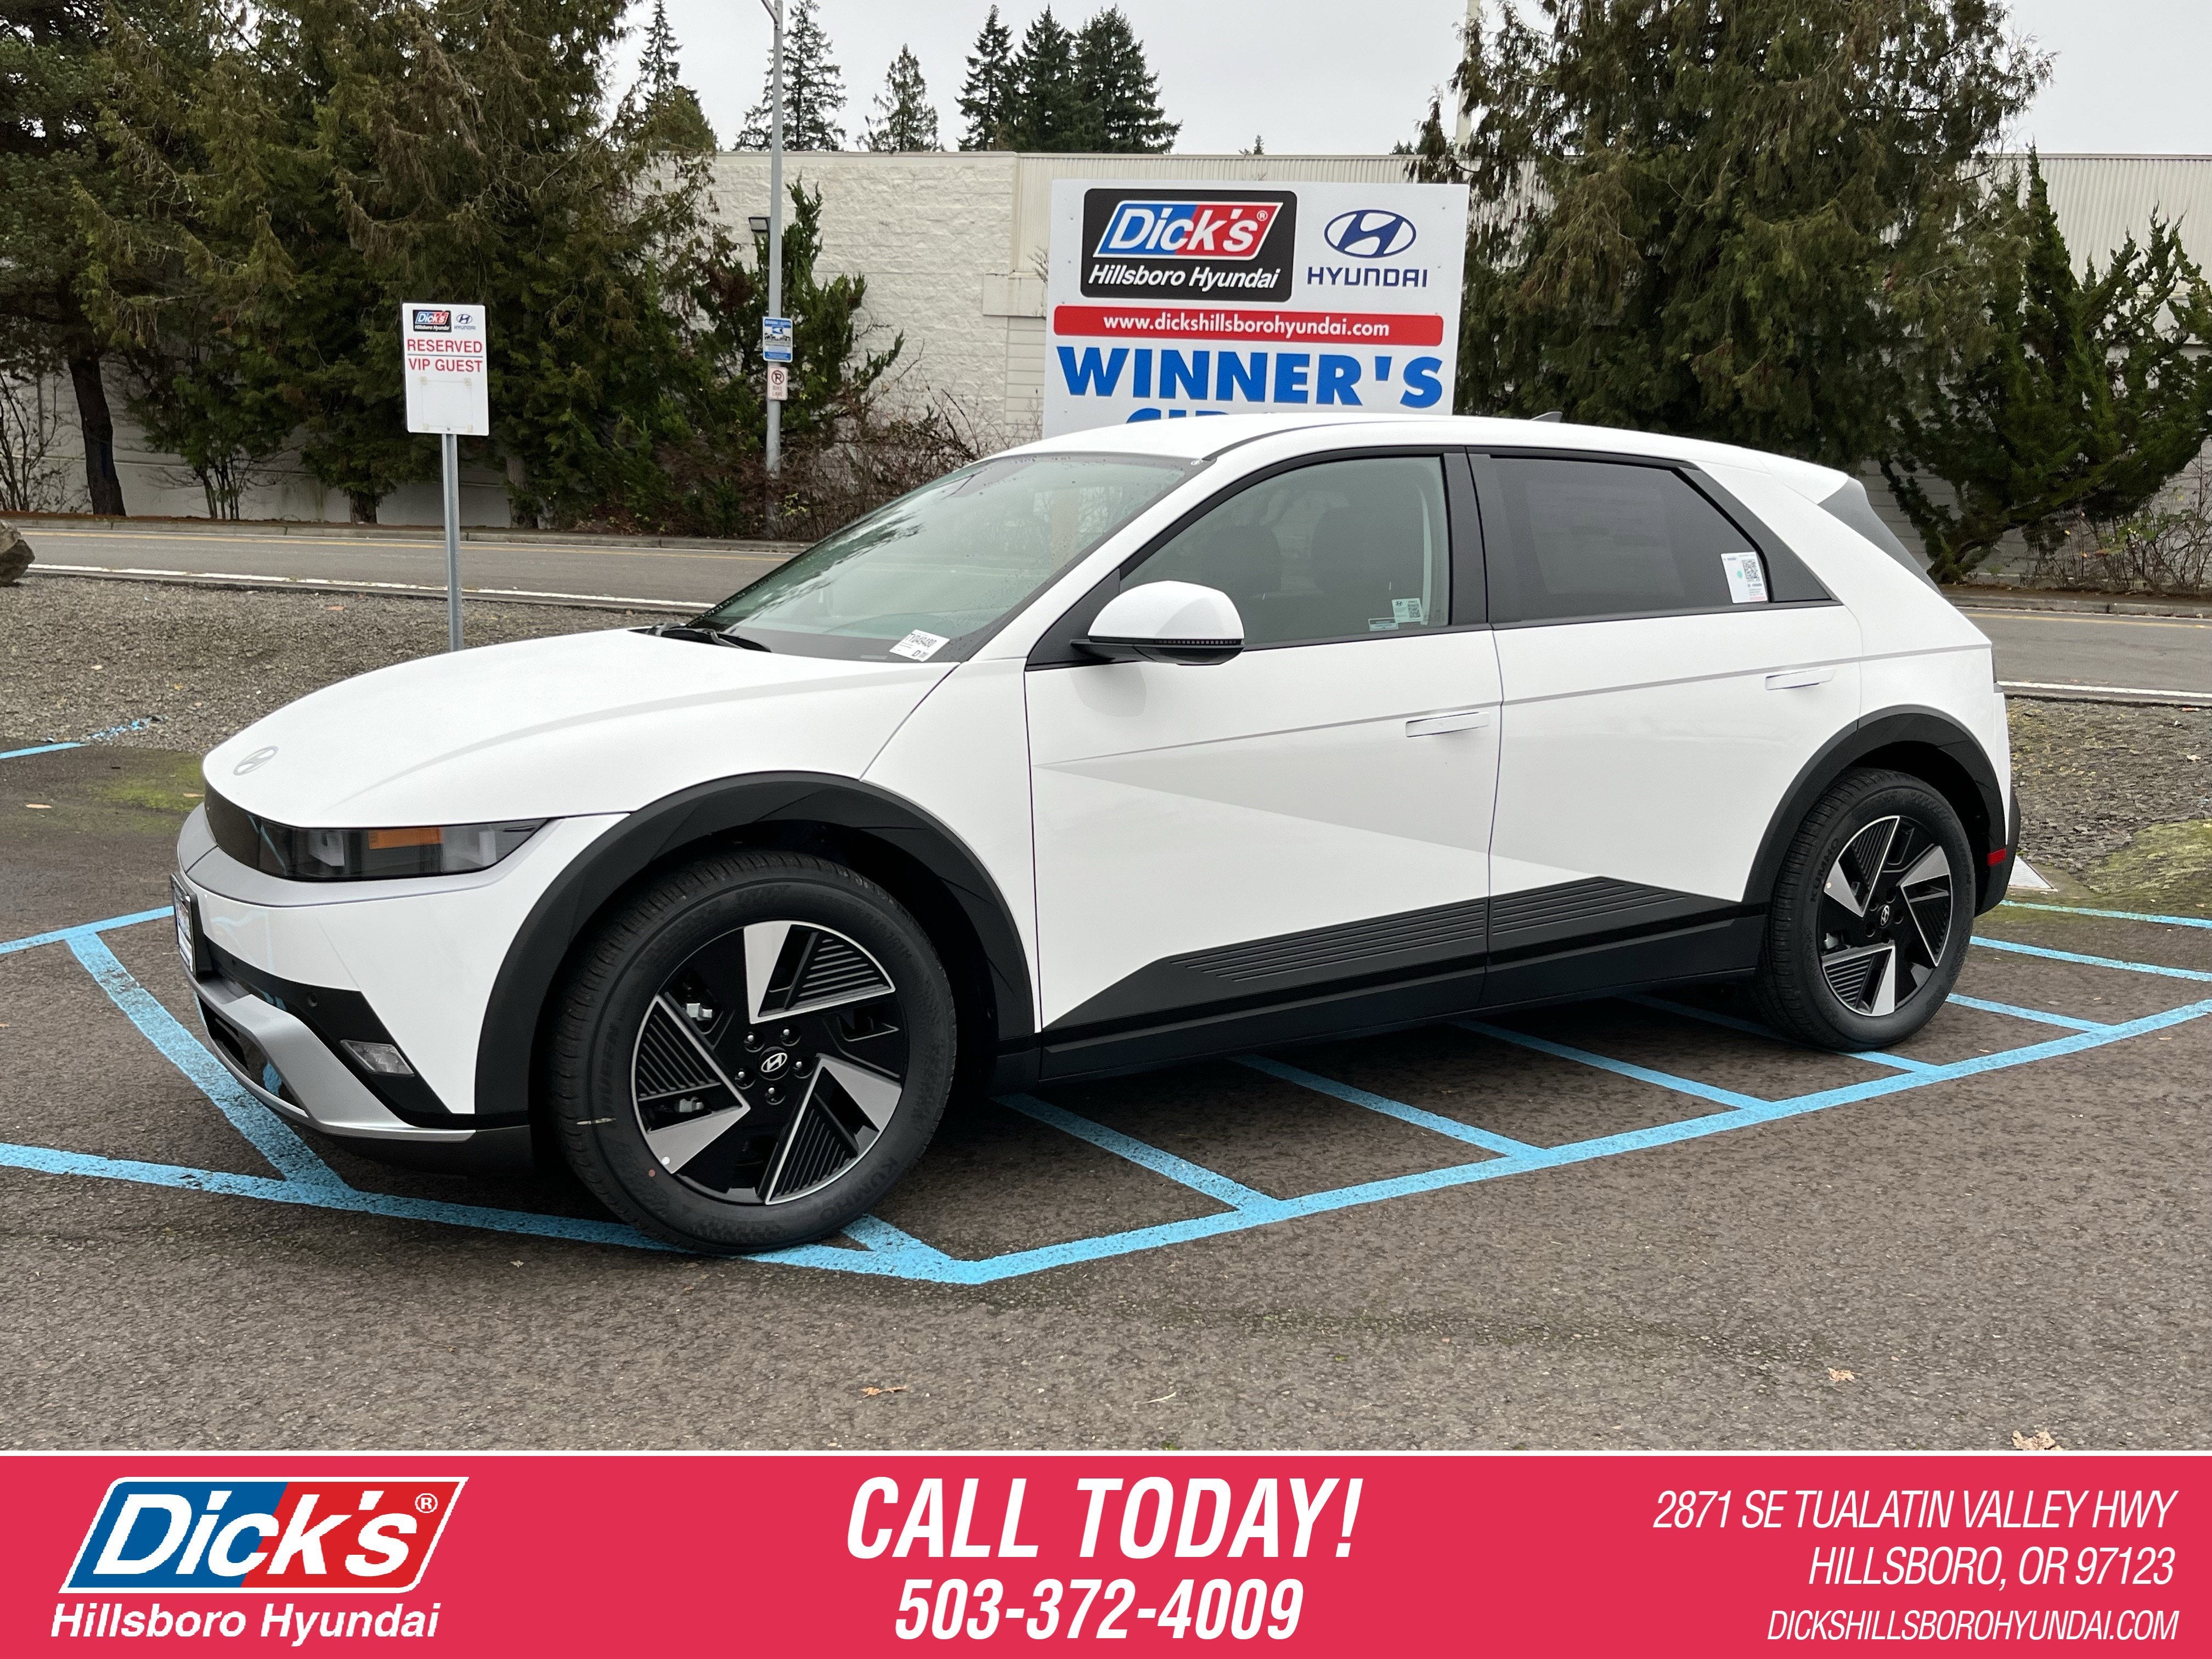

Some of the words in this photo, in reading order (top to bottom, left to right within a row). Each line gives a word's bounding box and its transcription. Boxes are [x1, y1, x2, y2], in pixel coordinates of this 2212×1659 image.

[1108, 208, 1259, 252] Dick's
[1088, 264, 1186, 286] Hillsboro
[1188, 267, 1281, 292] Hyundai
[1307, 267, 1427, 287] HYUNDAI
[1103, 314, 1390, 339] www.dickshillsborohyundai.com
[407, 339, 483, 353] RESERVED
[408, 358, 431, 370] VIP
[435, 359, 483, 372] GUEST
[1057, 346, 1443, 408] WINNER'S
[1810, 838, 1839, 902] KUMHO
